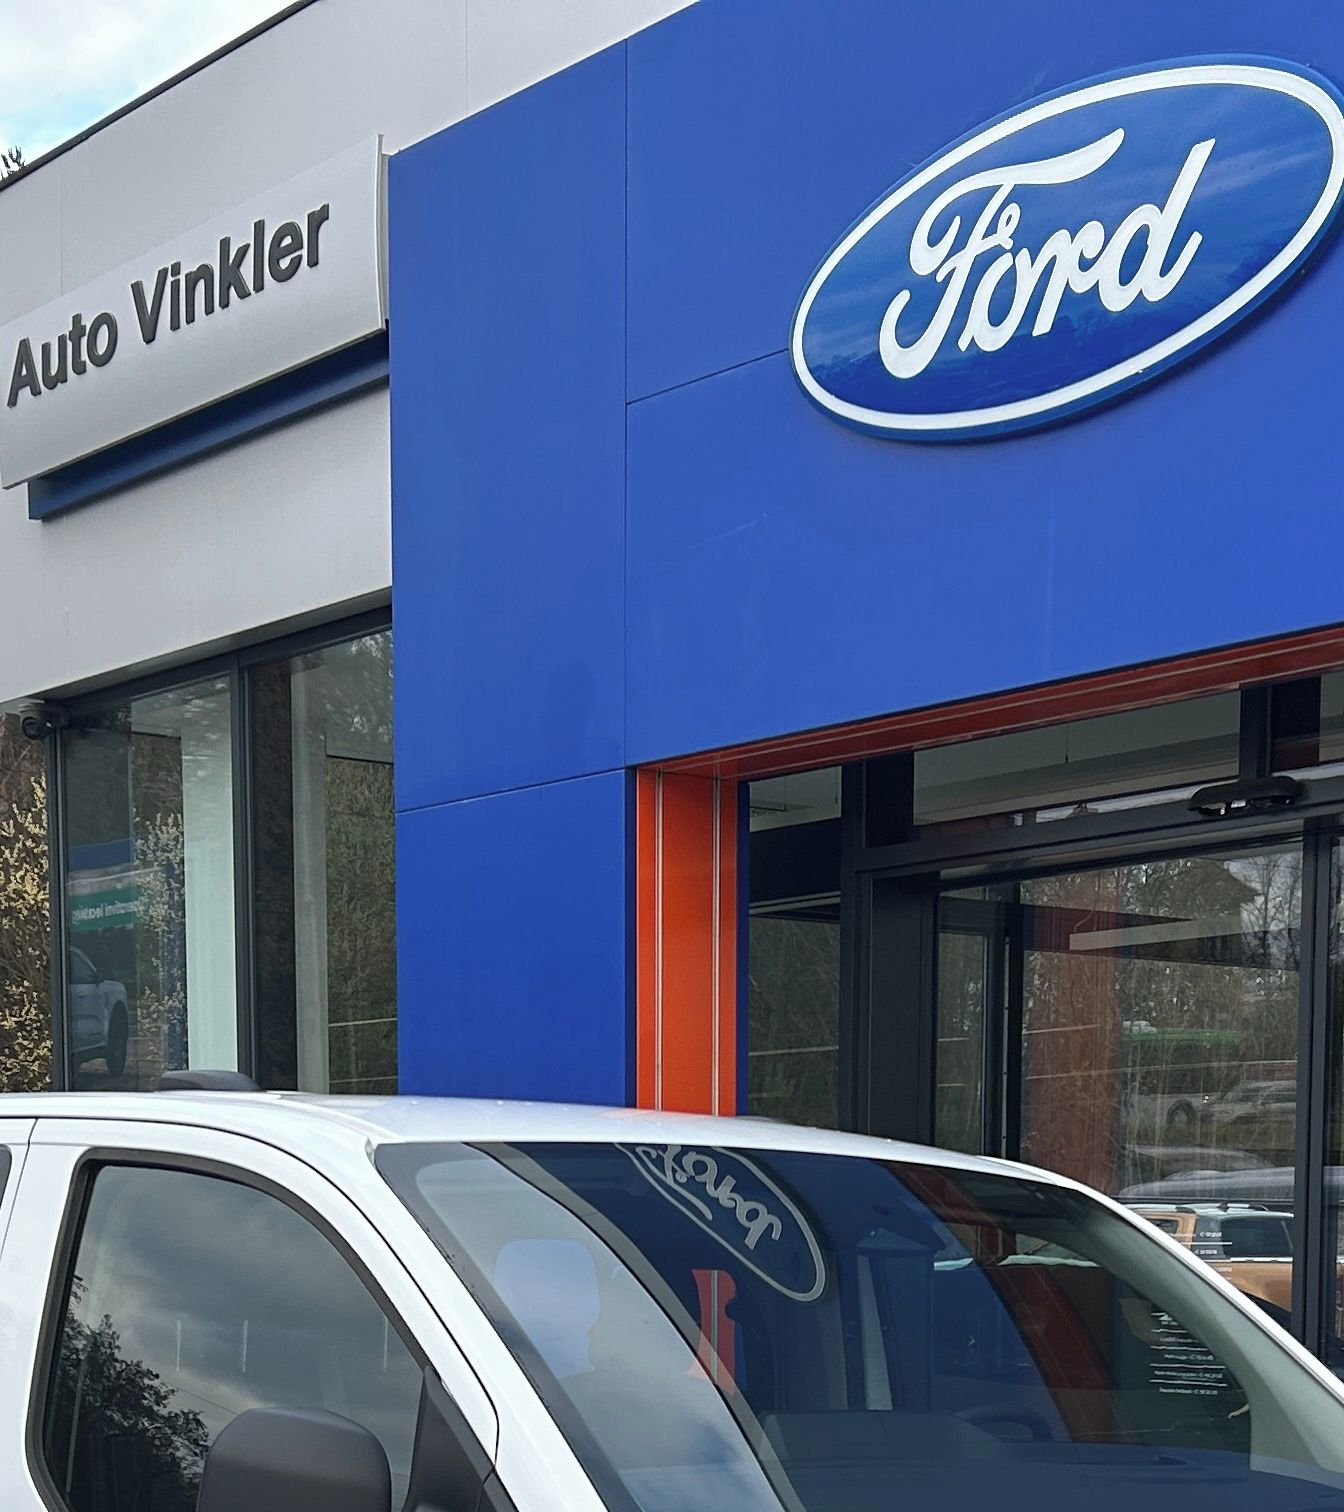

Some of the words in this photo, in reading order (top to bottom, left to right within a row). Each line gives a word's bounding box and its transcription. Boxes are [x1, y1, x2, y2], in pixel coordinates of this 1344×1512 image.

[6, 308, 119, 408] Auto
[131, 202, 330, 344] Vinkler
[878, 128, 1215, 380] Ford
